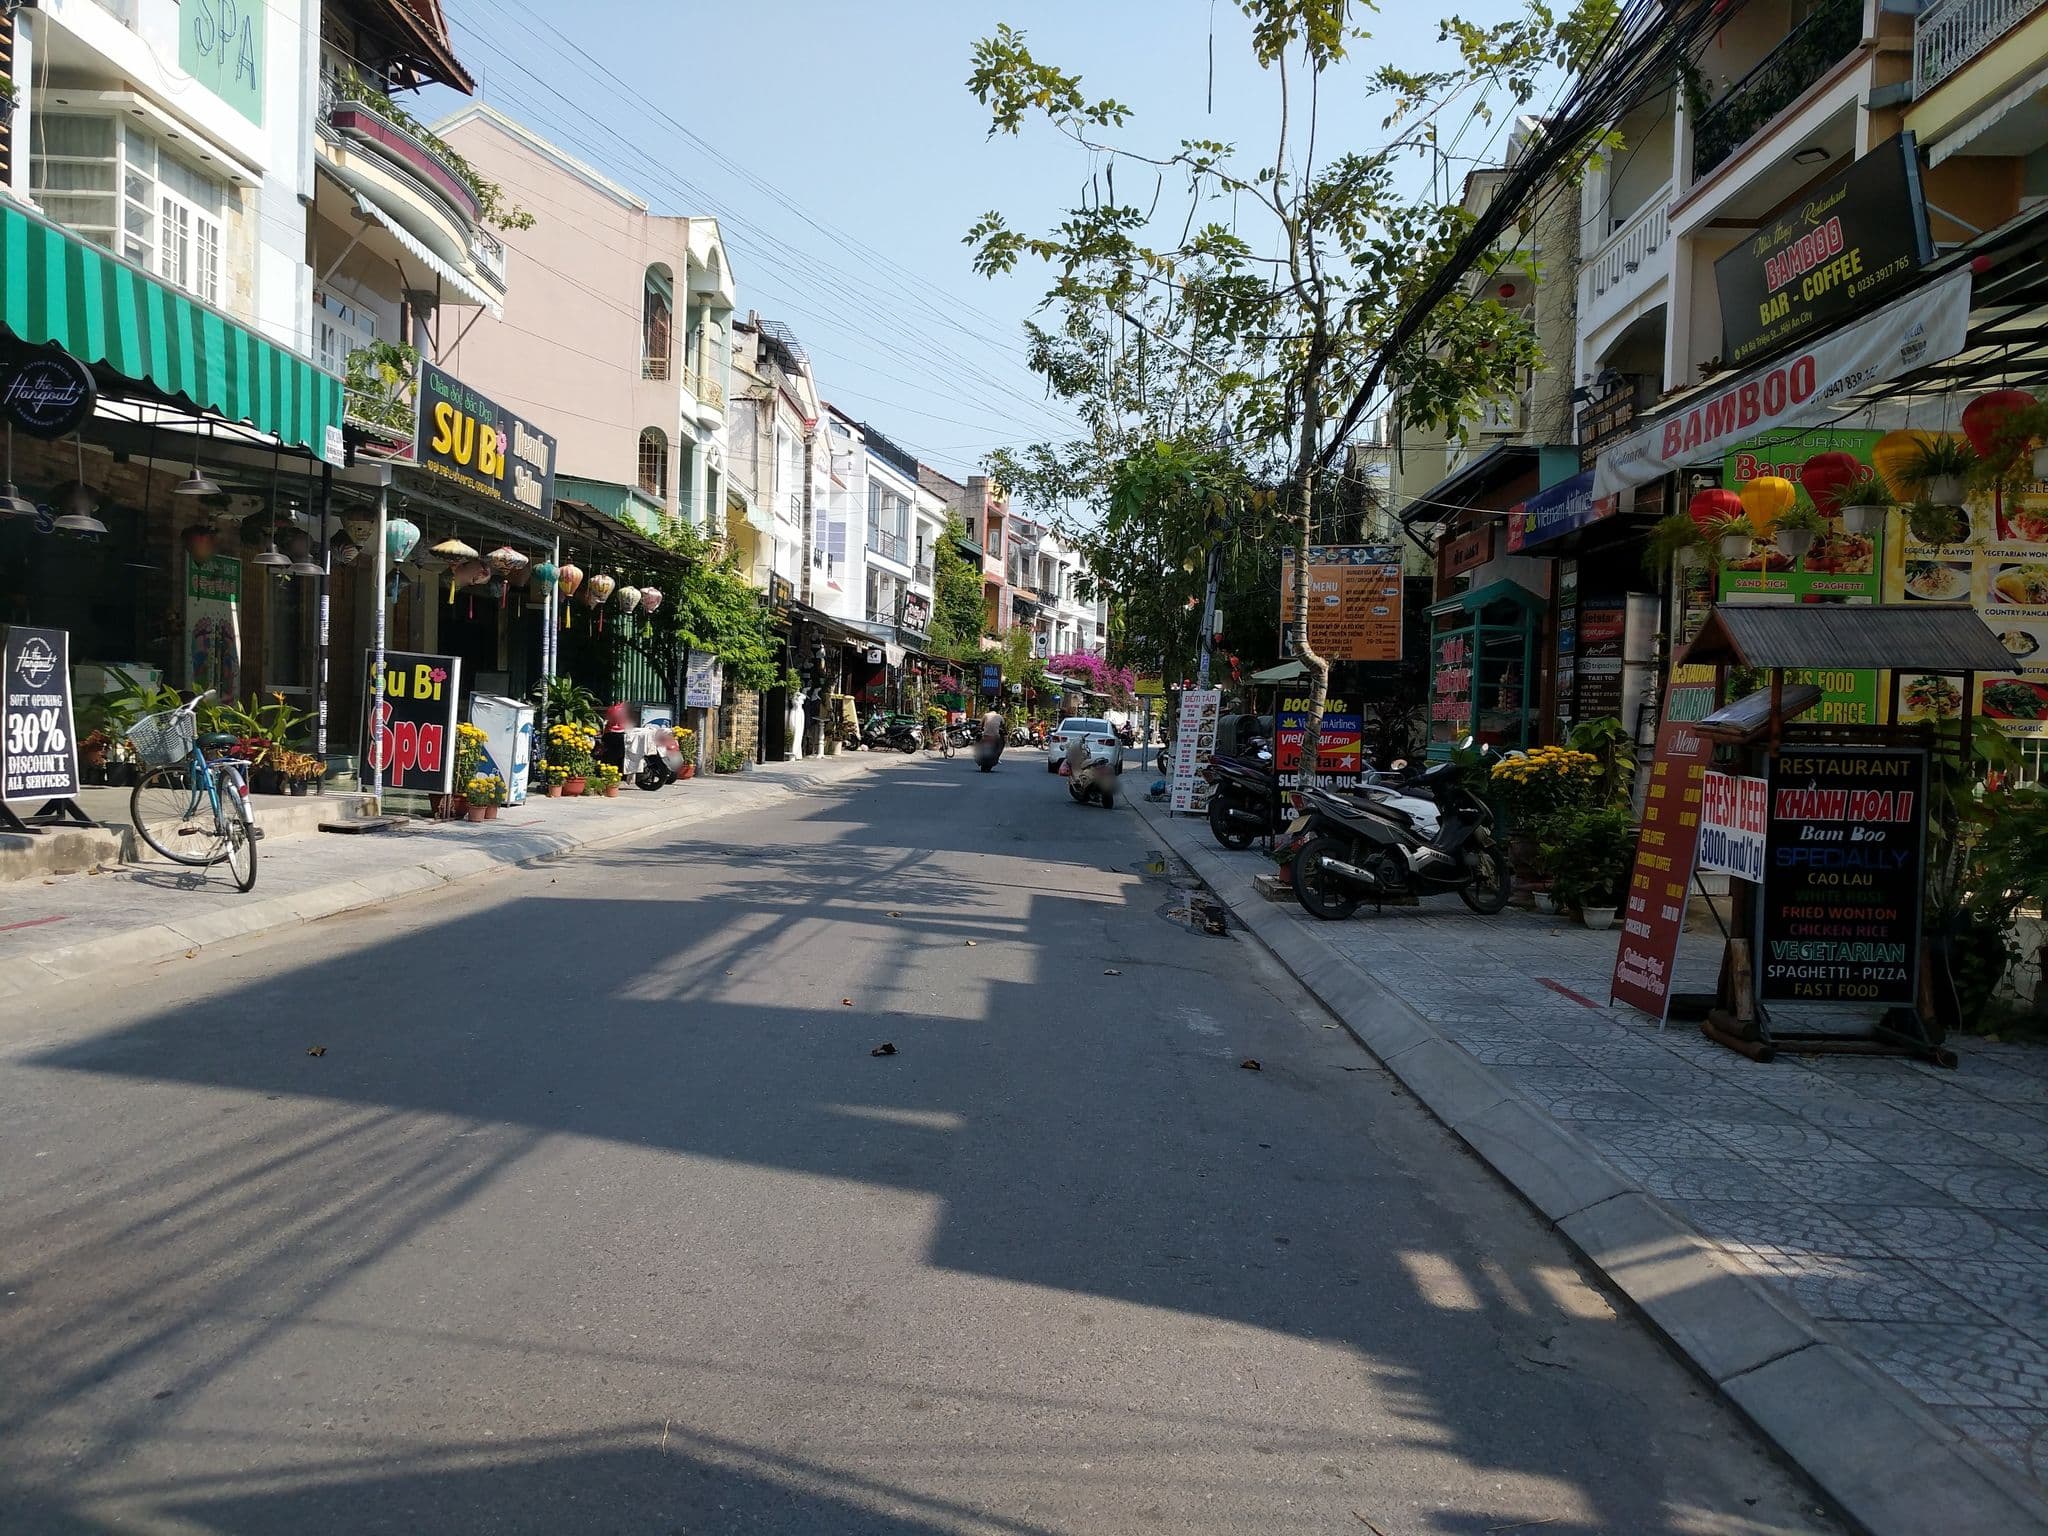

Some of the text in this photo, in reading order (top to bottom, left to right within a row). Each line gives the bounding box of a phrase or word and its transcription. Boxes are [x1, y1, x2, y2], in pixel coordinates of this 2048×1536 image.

[1764, 216, 1845, 294] BAMBOO
[1857, 255, 1910, 292] 0235 3917 765
[1759, 291, 1790, 326] BAR
[1802, 248, 1864, 302] COFFEE
[35, 373, 52, 390] the
[4, 373, 77, 413] Hangout
[1661, 354, 1817, 461] BAMBOO
[432, 401, 475, 466] SU
[1745, 436, 1865, 449] RESTAURANT
[1735, 453, 1875, 484] Bamo
[514, 465, 543, 510] Salon
[1983, 550, 2027, 558] VEGETARIAN
[1312, 582, 1338, 592] MENU
[1812, 581, 1864, 591] SPAGHETTI
[1985, 608, 2020, 617] COUNTRY
[413, 664, 442, 700] Bi
[1817, 671, 1855, 693] FOOD
[9, 694, 63, 707] SOFT OPENING
[8, 708, 66, 754] 30%
[1668, 729, 1701, 753] Menu
[367, 700, 443, 787] Spa
[8, 754, 69, 775] DISCOUNT
[1779, 758, 1911, 776] RESTAURANT
[8, 774, 70, 791] ALL SERVICES
[1336, 775, 1357, 789] BUS
[1704, 774, 1767, 835] FRESH BEER
[1847, 789, 1894, 823] HOA
[1895, 790, 1914, 823] II
[1800, 825, 1887, 842] Bam Boo
[1702, 828, 1727, 867] 3000
[1775, 847, 1912, 870] SPECIALLY
[1808, 872, 1873, 886] CAO LAU
[1782, 905, 1897, 921] FRIED WONTON
[1789, 922, 1889, 938] CHICKEN RICE
[1770, 940, 1905, 963] VEGETARIAN
[1767, 965, 1850, 979] SPAGHETTI
[1863, 967, 1908, 981] PIZZA
[1793, 982, 1880, 998] FAST FOOD
